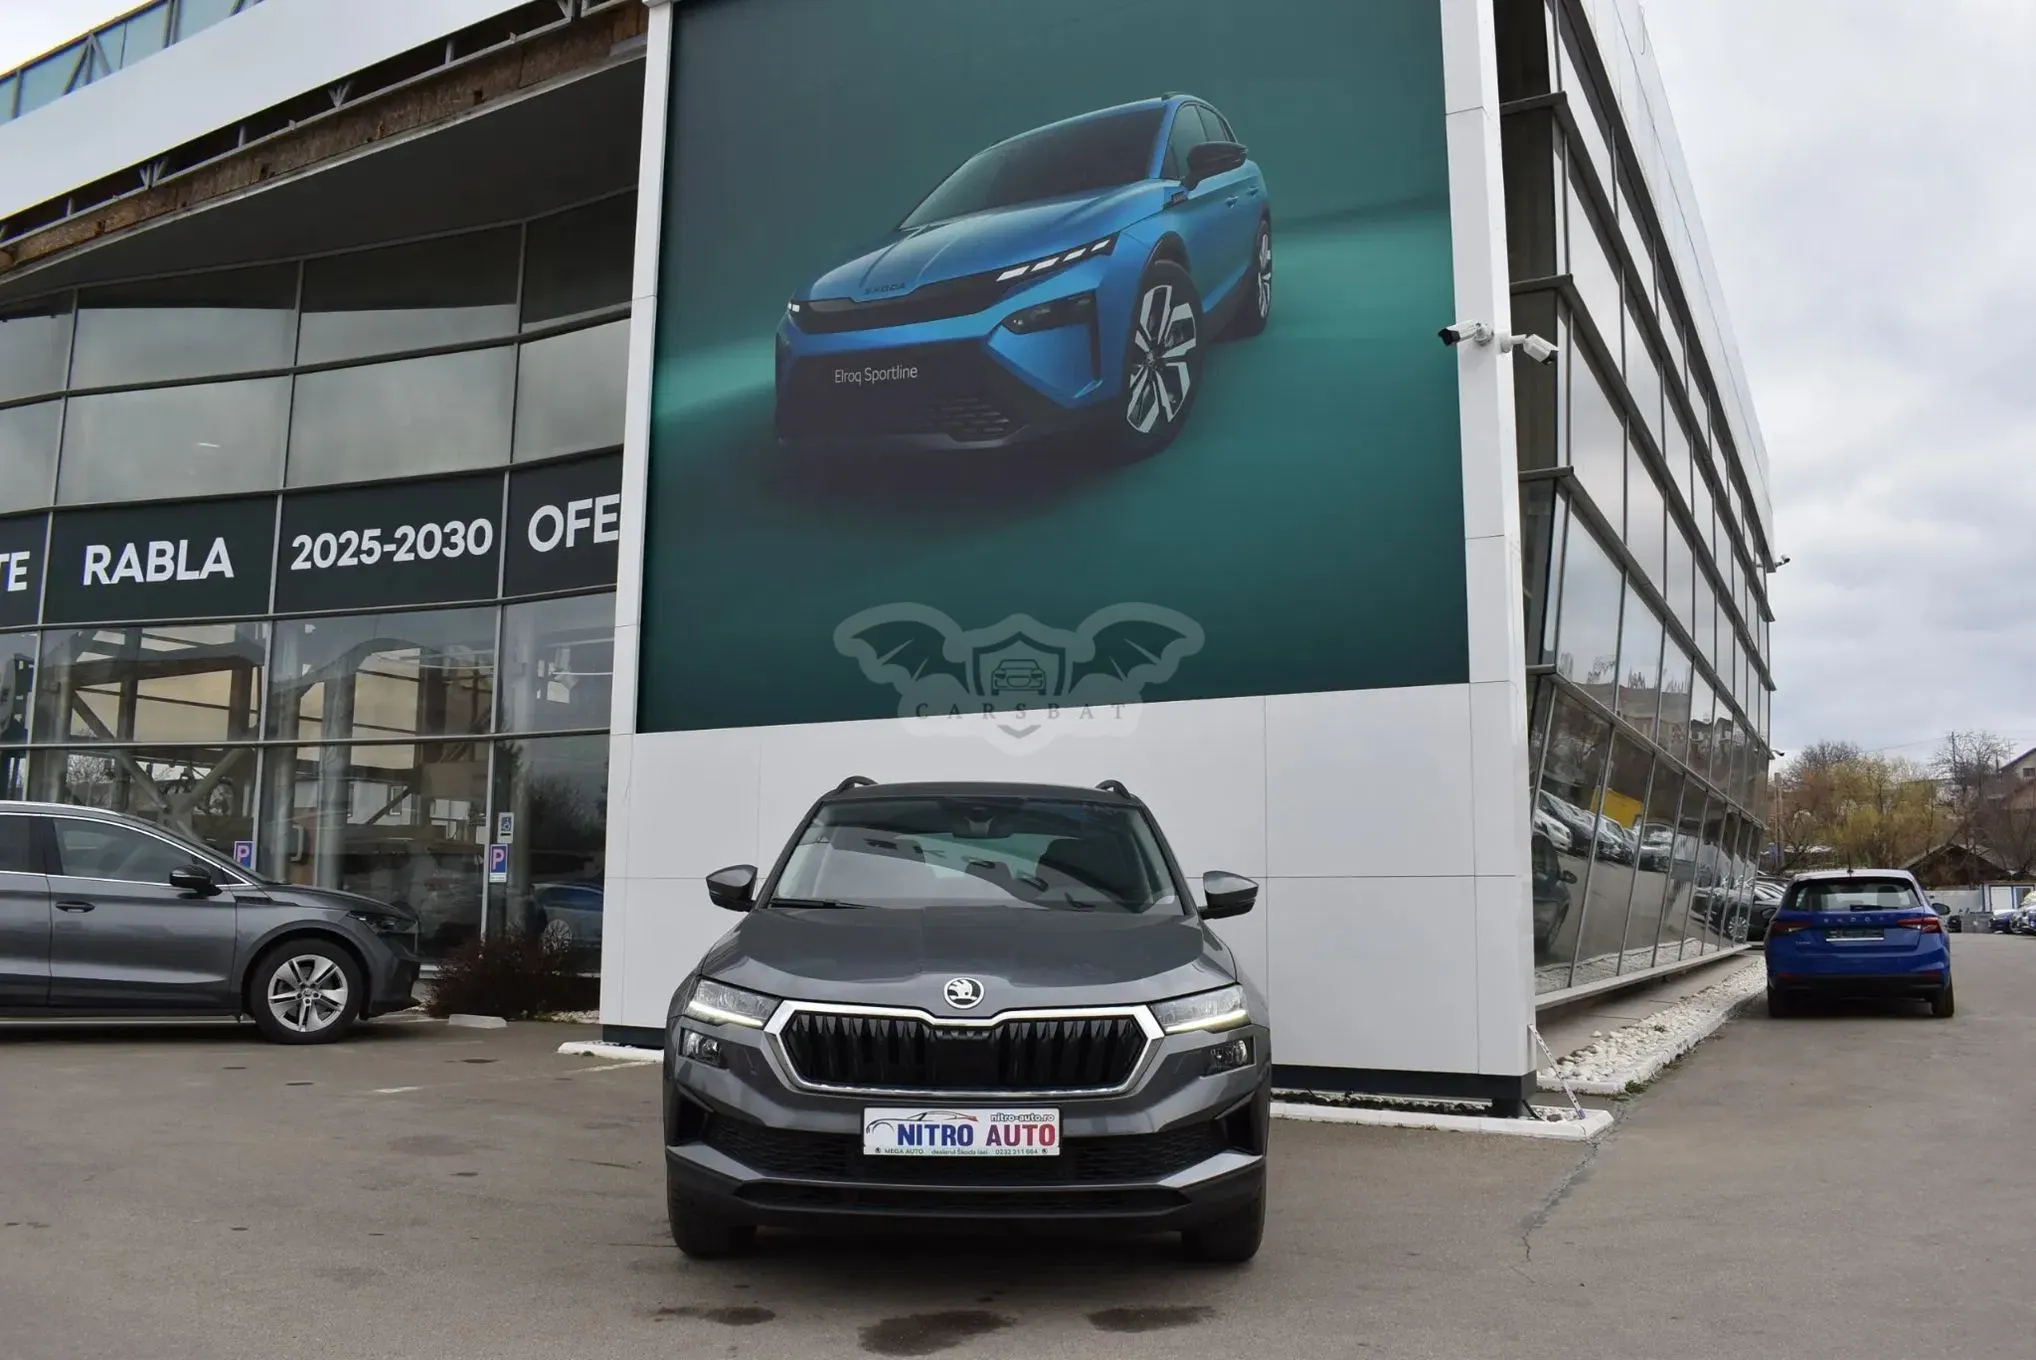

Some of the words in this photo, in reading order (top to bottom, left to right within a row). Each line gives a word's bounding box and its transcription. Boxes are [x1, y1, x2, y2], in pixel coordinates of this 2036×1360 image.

[834, 369, 862, 386] Elroq
[864, 364, 918, 384] Sportline
[83, 537, 235, 586] RABLA
[291, 518, 493, 570] 2025-2030
[528, 493, 620, 552] OFE
[237, 845, 250, 864] P
[492, 848, 505, 871] P
[990, 1113, 1055, 1122] nitro-auto.ro
[897, 1124, 974, 1147] NITRO
[985, 1124, 1056, 1147] AUTO
